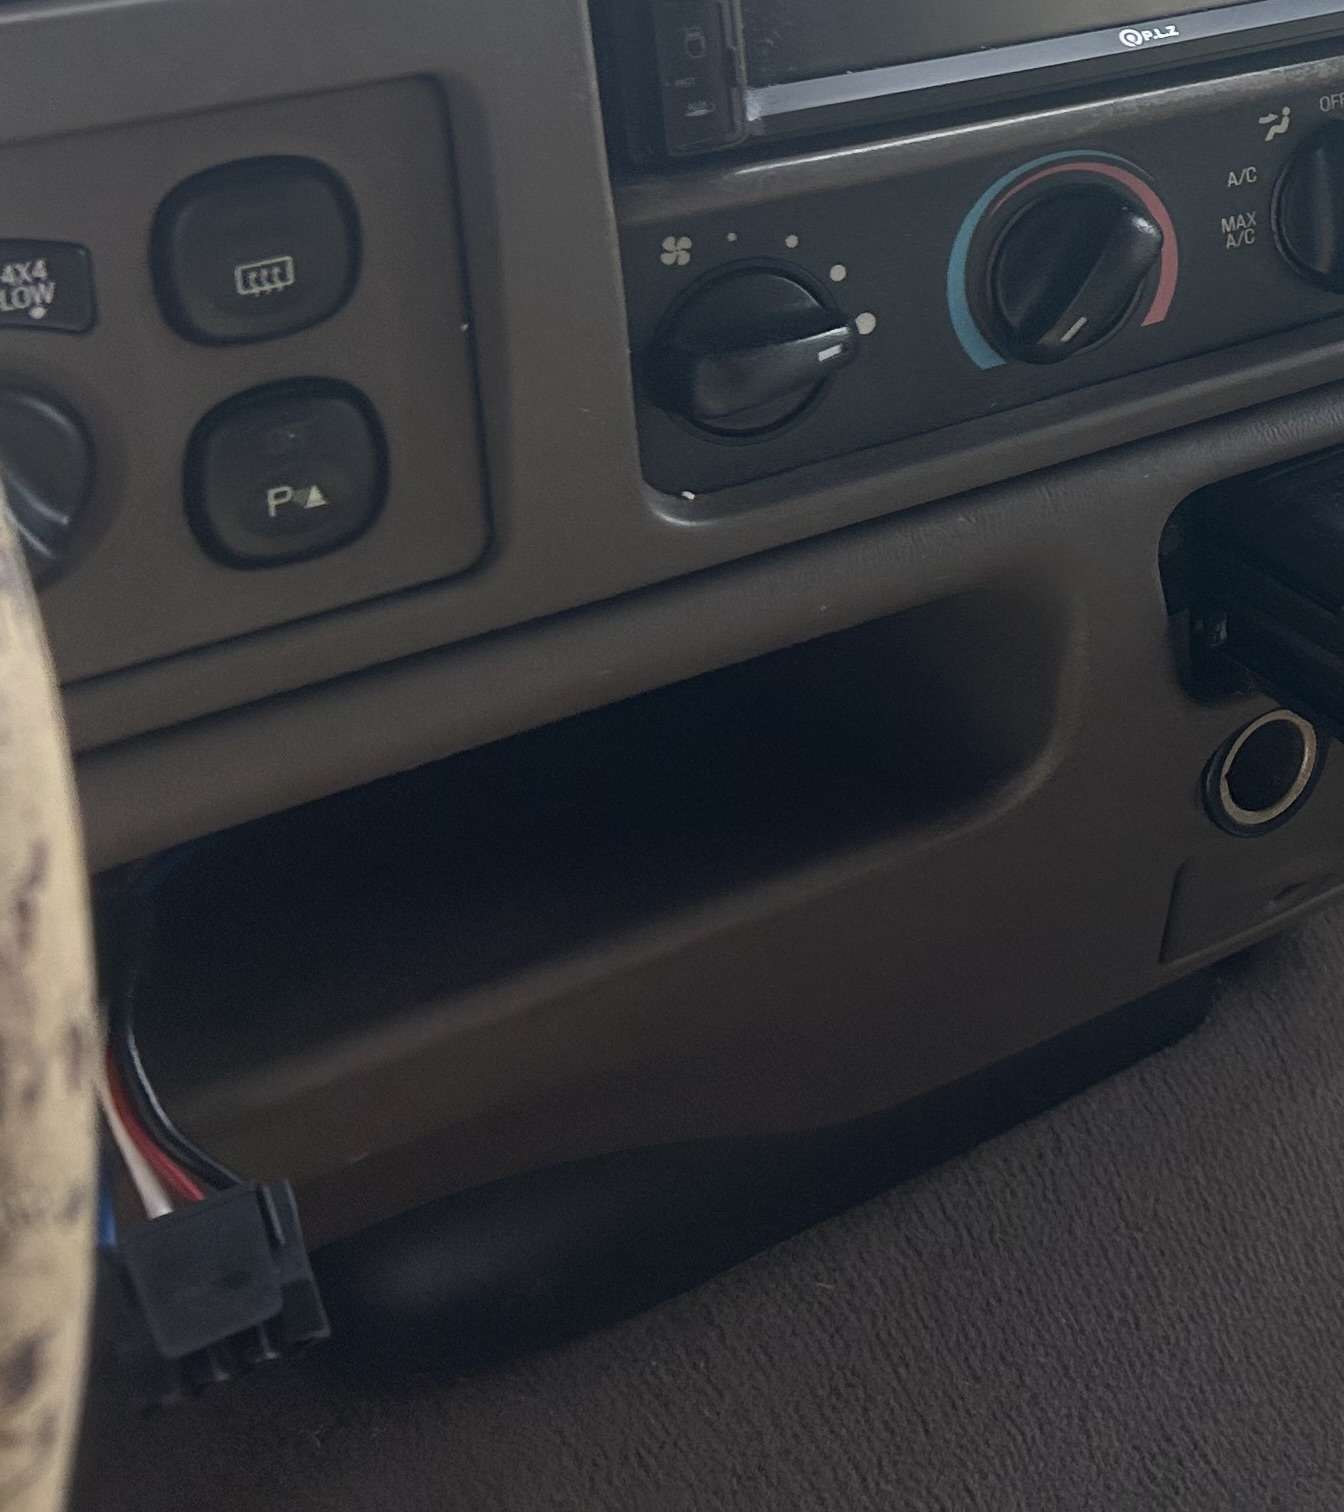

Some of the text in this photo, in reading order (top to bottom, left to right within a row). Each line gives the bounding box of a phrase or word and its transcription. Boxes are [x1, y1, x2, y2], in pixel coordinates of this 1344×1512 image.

[1227, 166, 1258, 188] A/C
[1221, 210, 1257, 234] MAX
[1225, 228, 1256, 250] A/C
[0, 281, 56, 312] LOW
